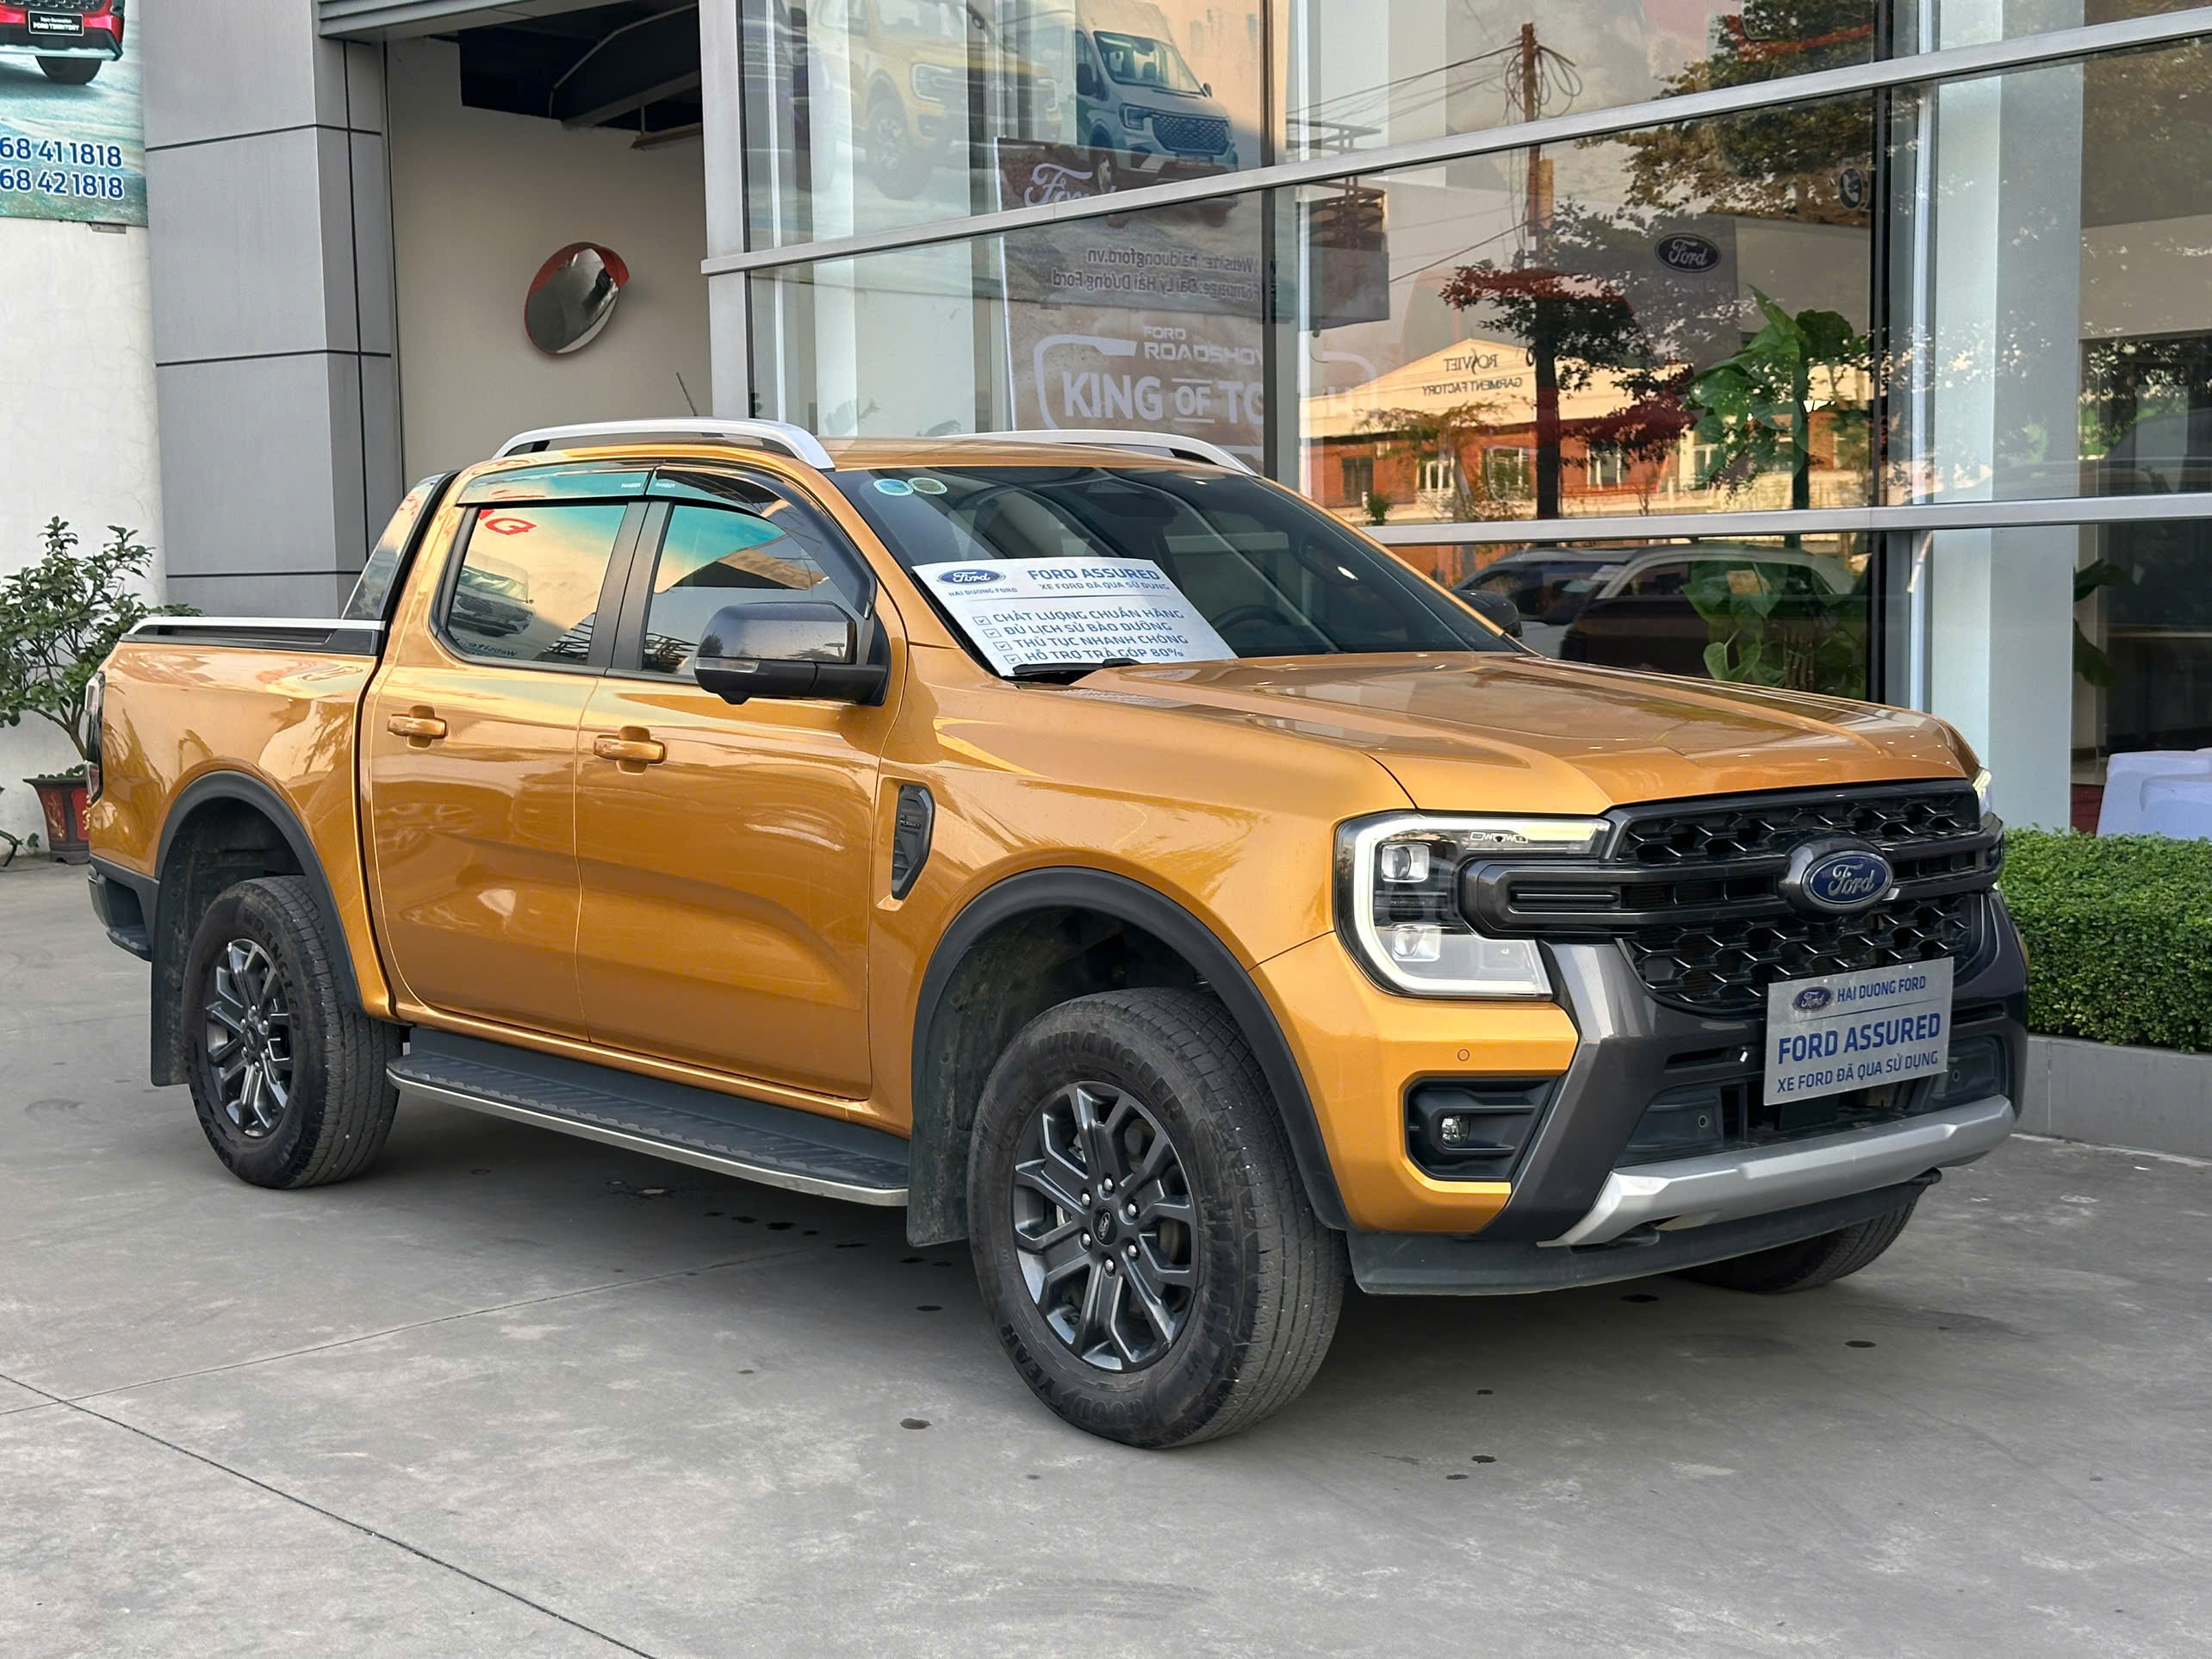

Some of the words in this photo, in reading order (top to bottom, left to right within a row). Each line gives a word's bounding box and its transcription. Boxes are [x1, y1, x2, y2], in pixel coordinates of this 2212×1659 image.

[0, 137, 31, 159] 68
[0, 169, 32, 191] 68
[1668, 239, 1709, 266] Ford
[1143, 326, 1186, 340] FORD
[1062, 371, 1163, 421] KING
[1175, 385, 1210, 416] OF
[1027, 569, 1078, 581] FORD
[1081, 568, 1160, 581] ASSURED
[1039, 582, 1054, 591] XE
[1103, 581, 1125, 589] QUA
[1028, 624, 1063, 635] LỊCH
[1047, 637, 1079, 648] TỤC
[1079, 636, 1137, 646] NHANH
[1137, 633, 1188, 644] CHÓNG
[1049, 649, 1083, 661] TRỢ
[1117, 647, 1147, 657] GÓP
[1149, 648, 1184, 657] 80%
[1827, 864, 1875, 897] Ford
[1837, 988, 1856, 1003] HAI
[1859, 981, 1896, 999] DUONG
[1898, 975, 1926, 993] FORD
[1778, 1030, 1838, 1065] FORD
[1843, 1012, 1941, 1053] ASSURED
[1777, 1077, 1794, 1094] XE
[1798, 1070, 1833, 1090] FORD
[1836, 1063, 1854, 1083] ĐÃ
[1857, 1060, 1883, 1080] QUA
[1886, 1053, 1902, 1074] SỬ
[1904, 1050, 1938, 1072] DỤNG
